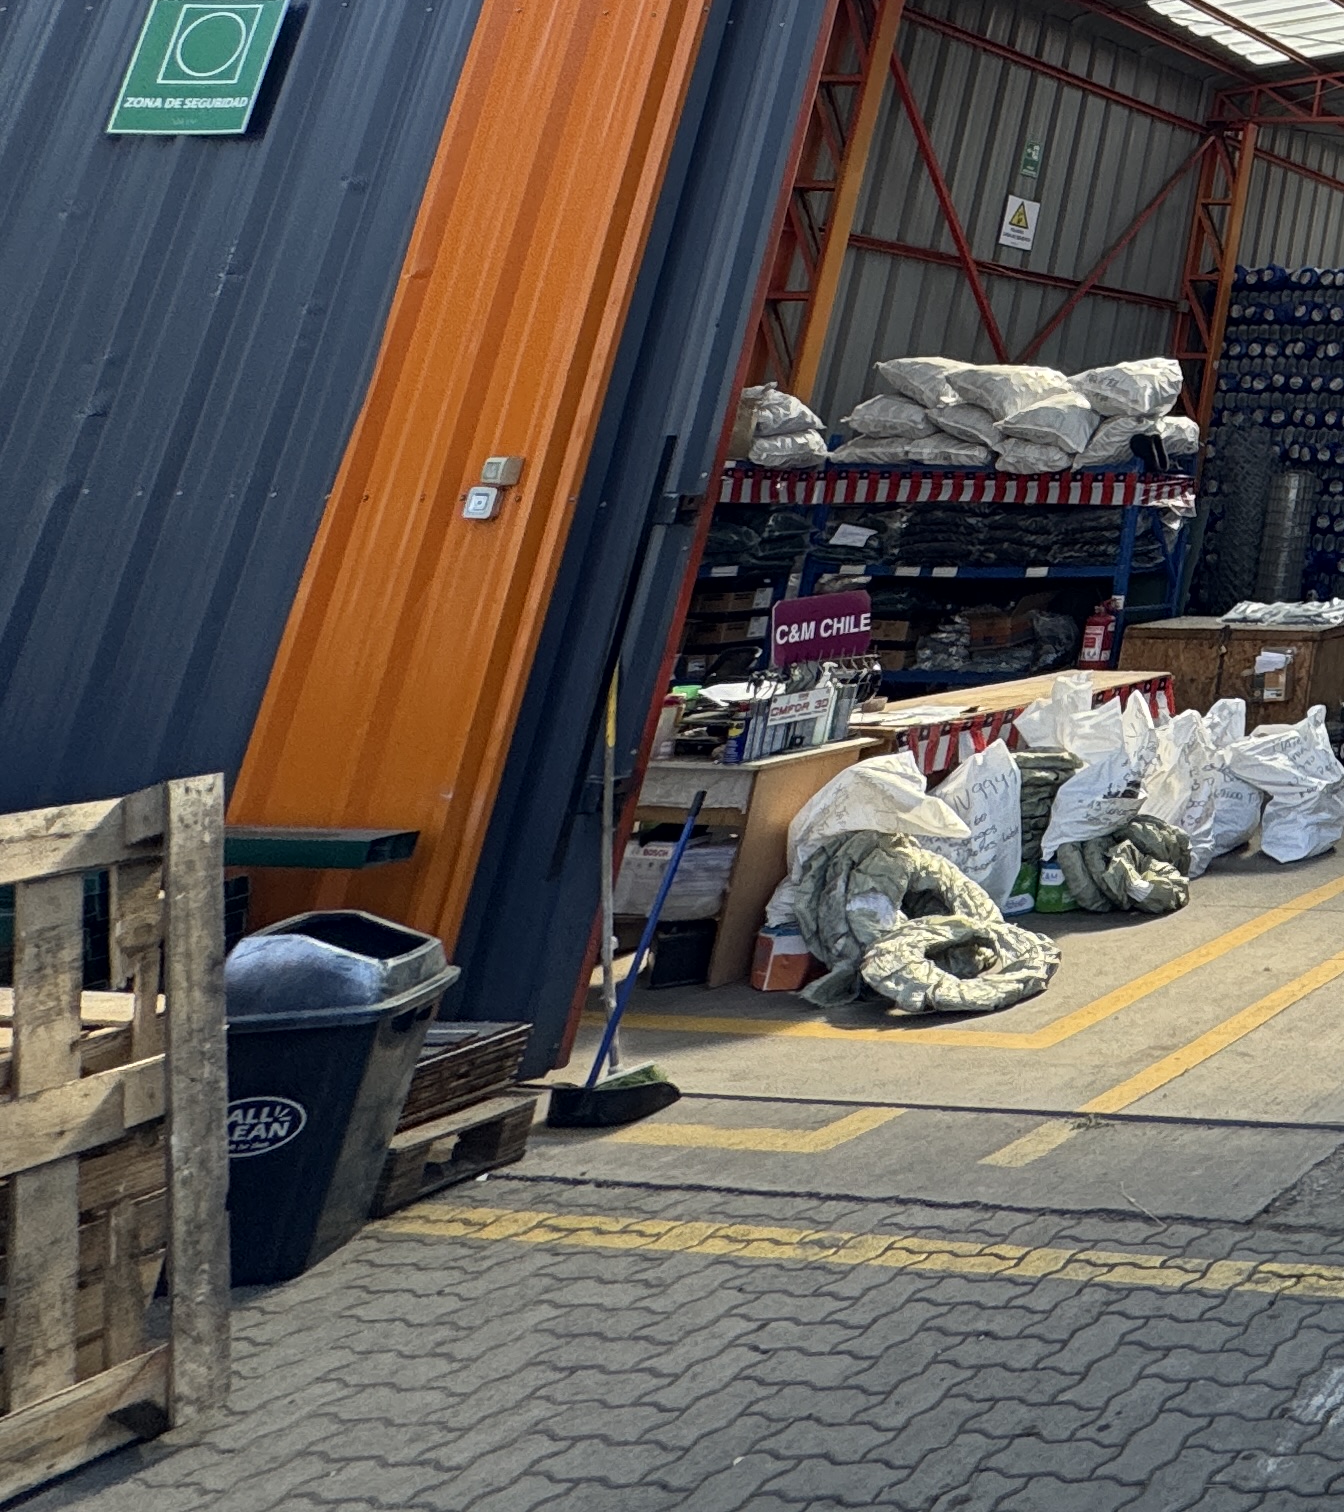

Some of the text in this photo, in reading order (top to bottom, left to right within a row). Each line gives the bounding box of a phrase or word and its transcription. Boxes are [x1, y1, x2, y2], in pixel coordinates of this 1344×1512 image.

[123, 96, 248, 109] ZONA DE SEGURIDAD
[775, 612, 871, 645] C&M CHILE
